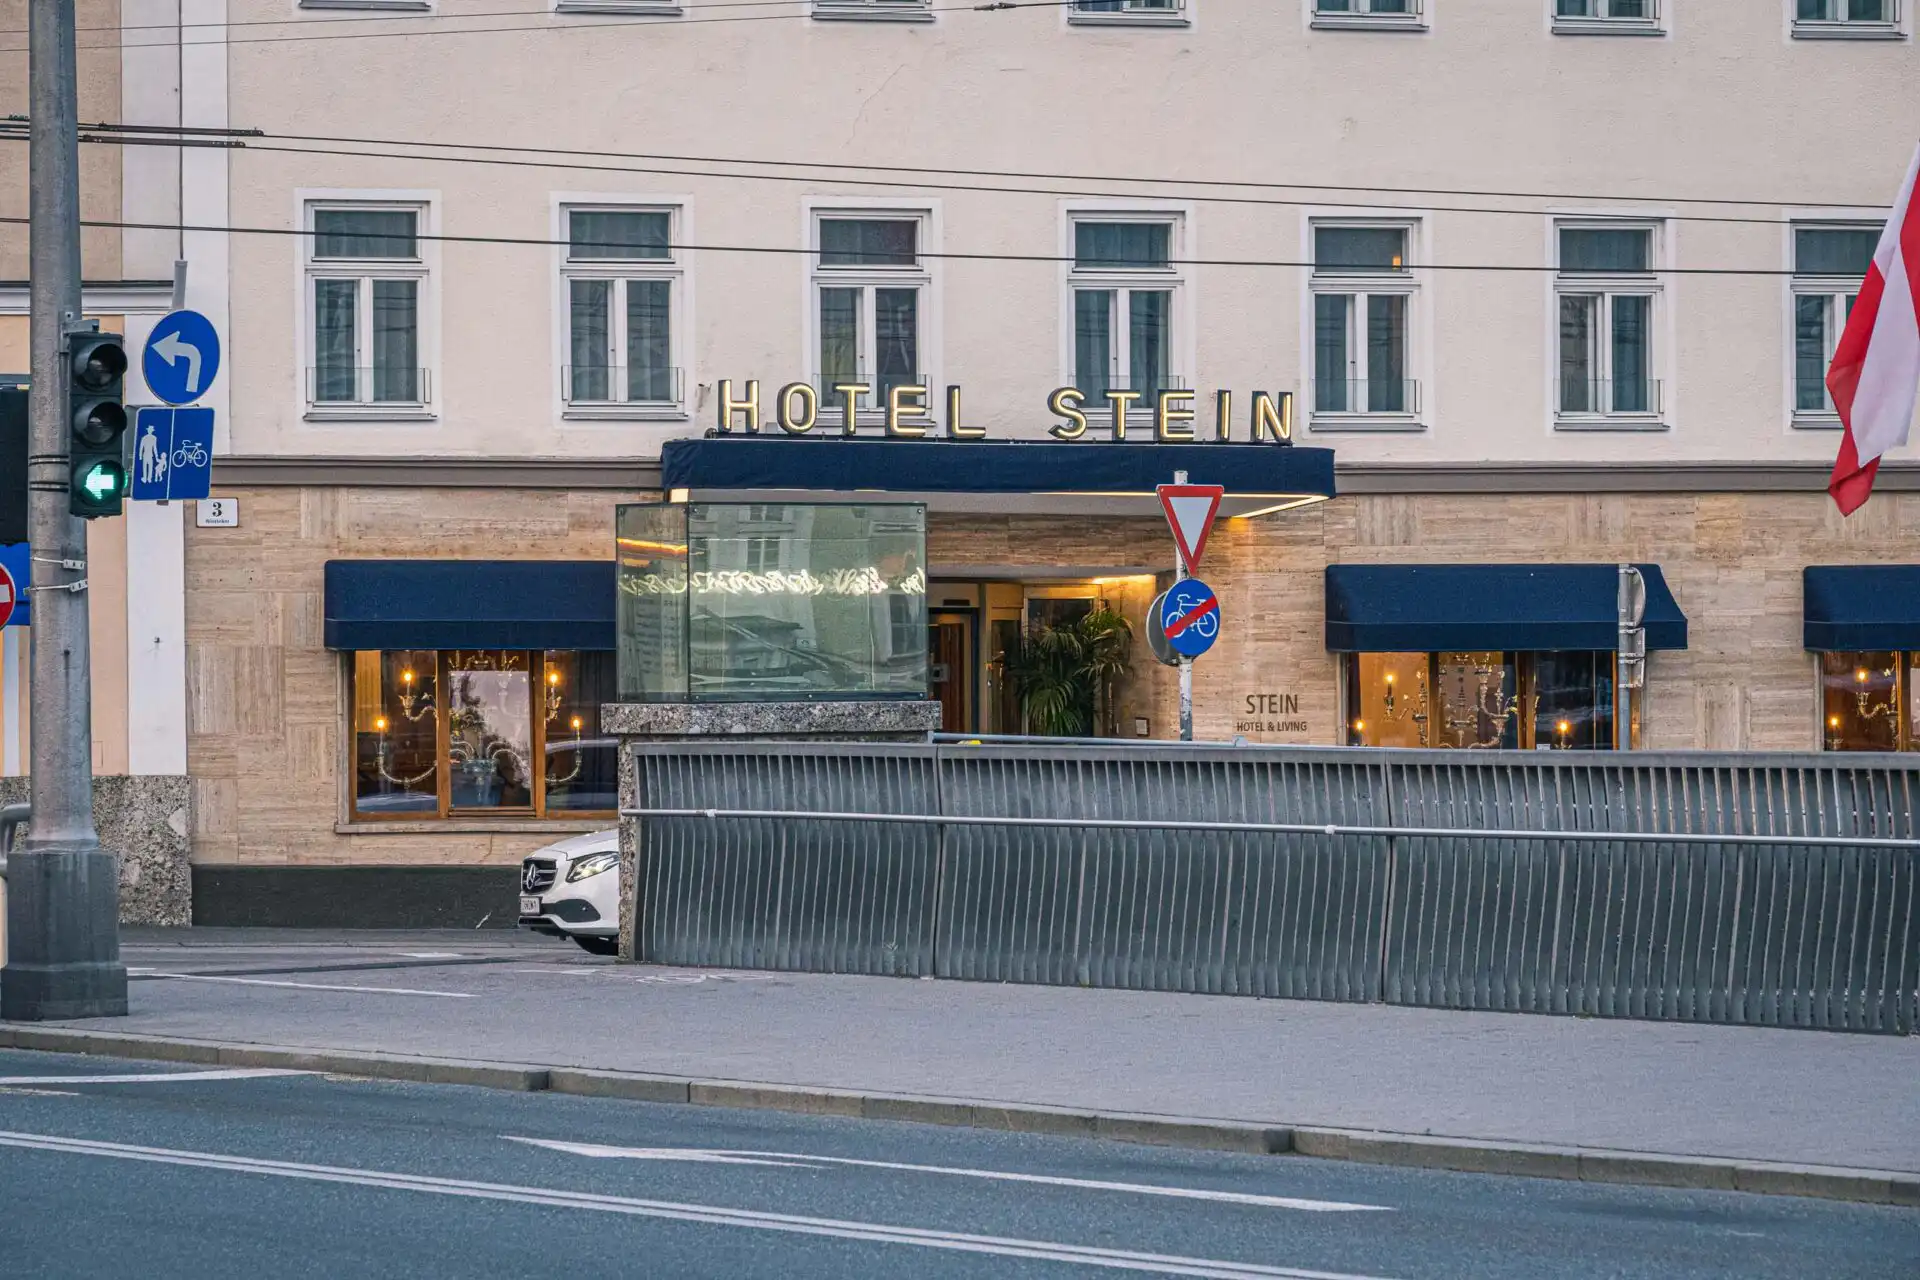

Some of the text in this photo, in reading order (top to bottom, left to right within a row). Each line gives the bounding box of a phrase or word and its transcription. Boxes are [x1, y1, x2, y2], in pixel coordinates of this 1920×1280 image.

[718, 379, 1294, 444] HOTEL STEIN
[212, 502, 222, 517] 3
[1246, 694, 1298, 714] STEIN
[1237, 721, 1307, 732] HOTEL & LIVING
